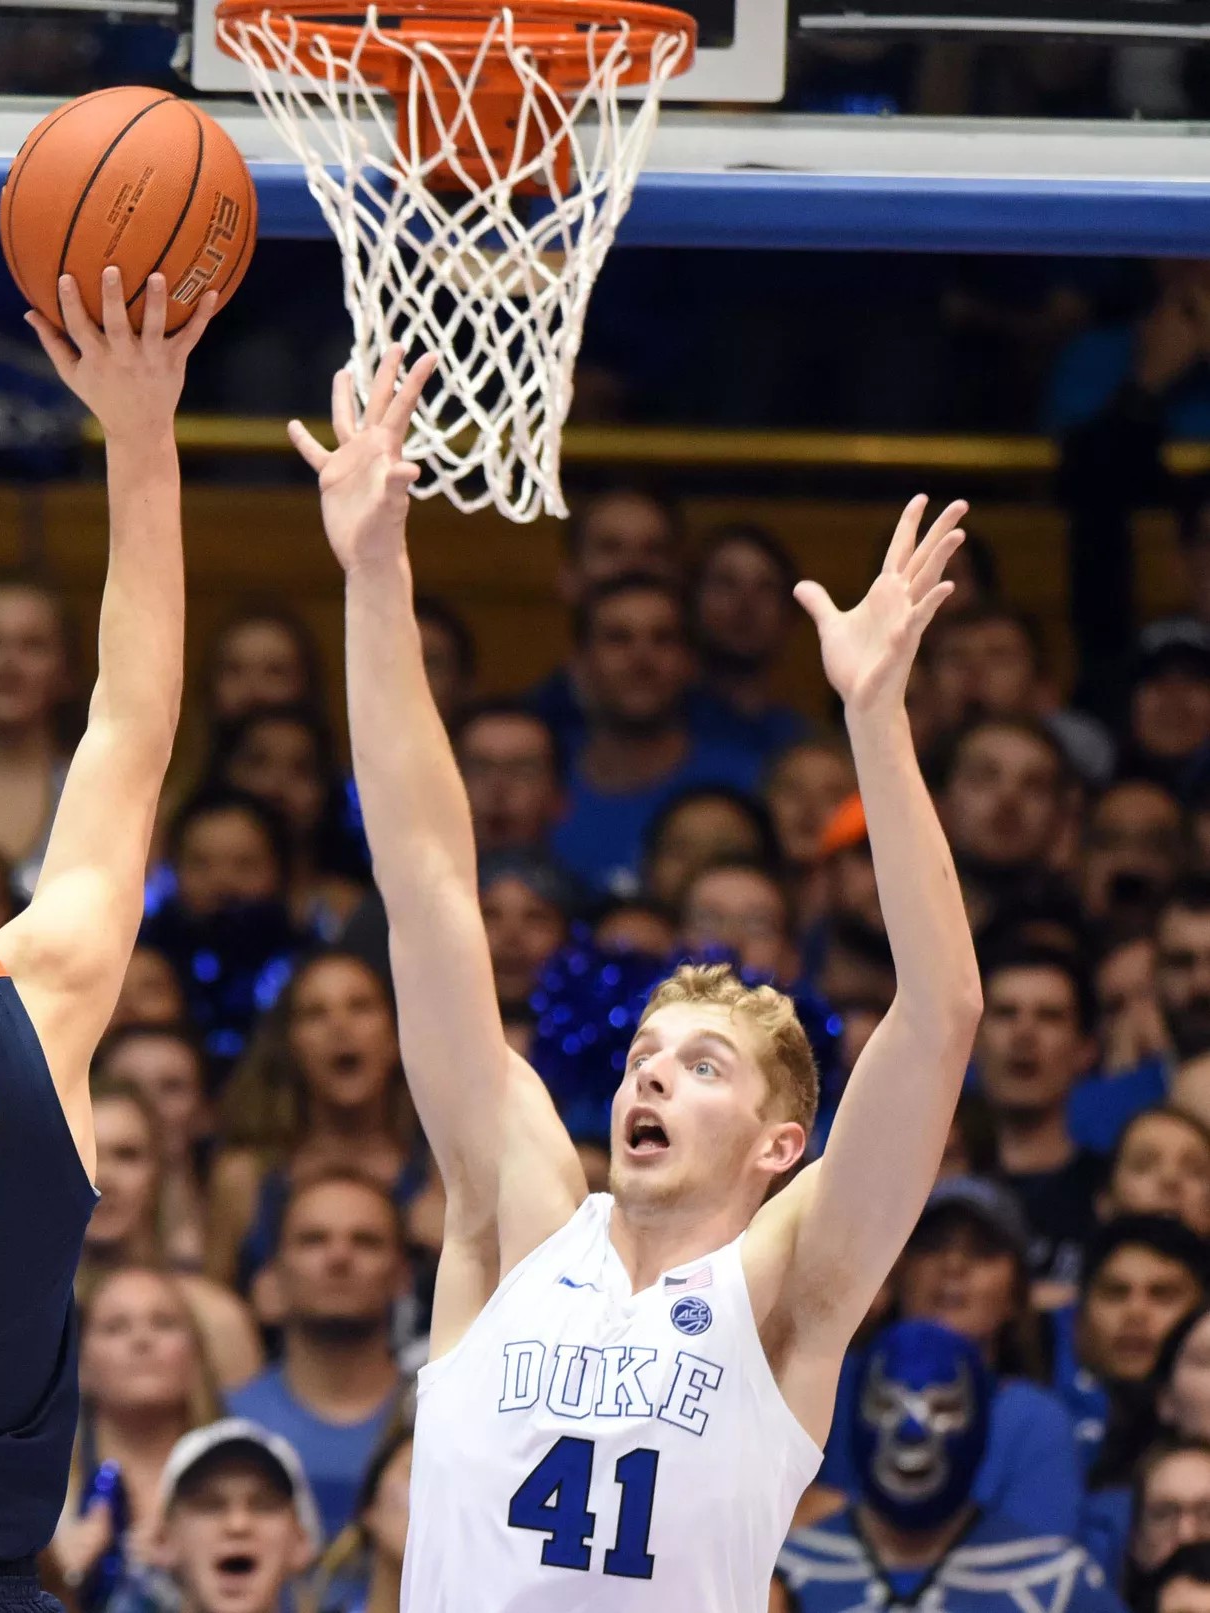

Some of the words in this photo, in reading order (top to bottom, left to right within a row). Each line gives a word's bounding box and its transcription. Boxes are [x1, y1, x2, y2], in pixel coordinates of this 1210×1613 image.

[172, 194, 240, 305] ELITE
[497, 1339, 724, 1437] DUKE
[507, 1434, 661, 1580] 41
